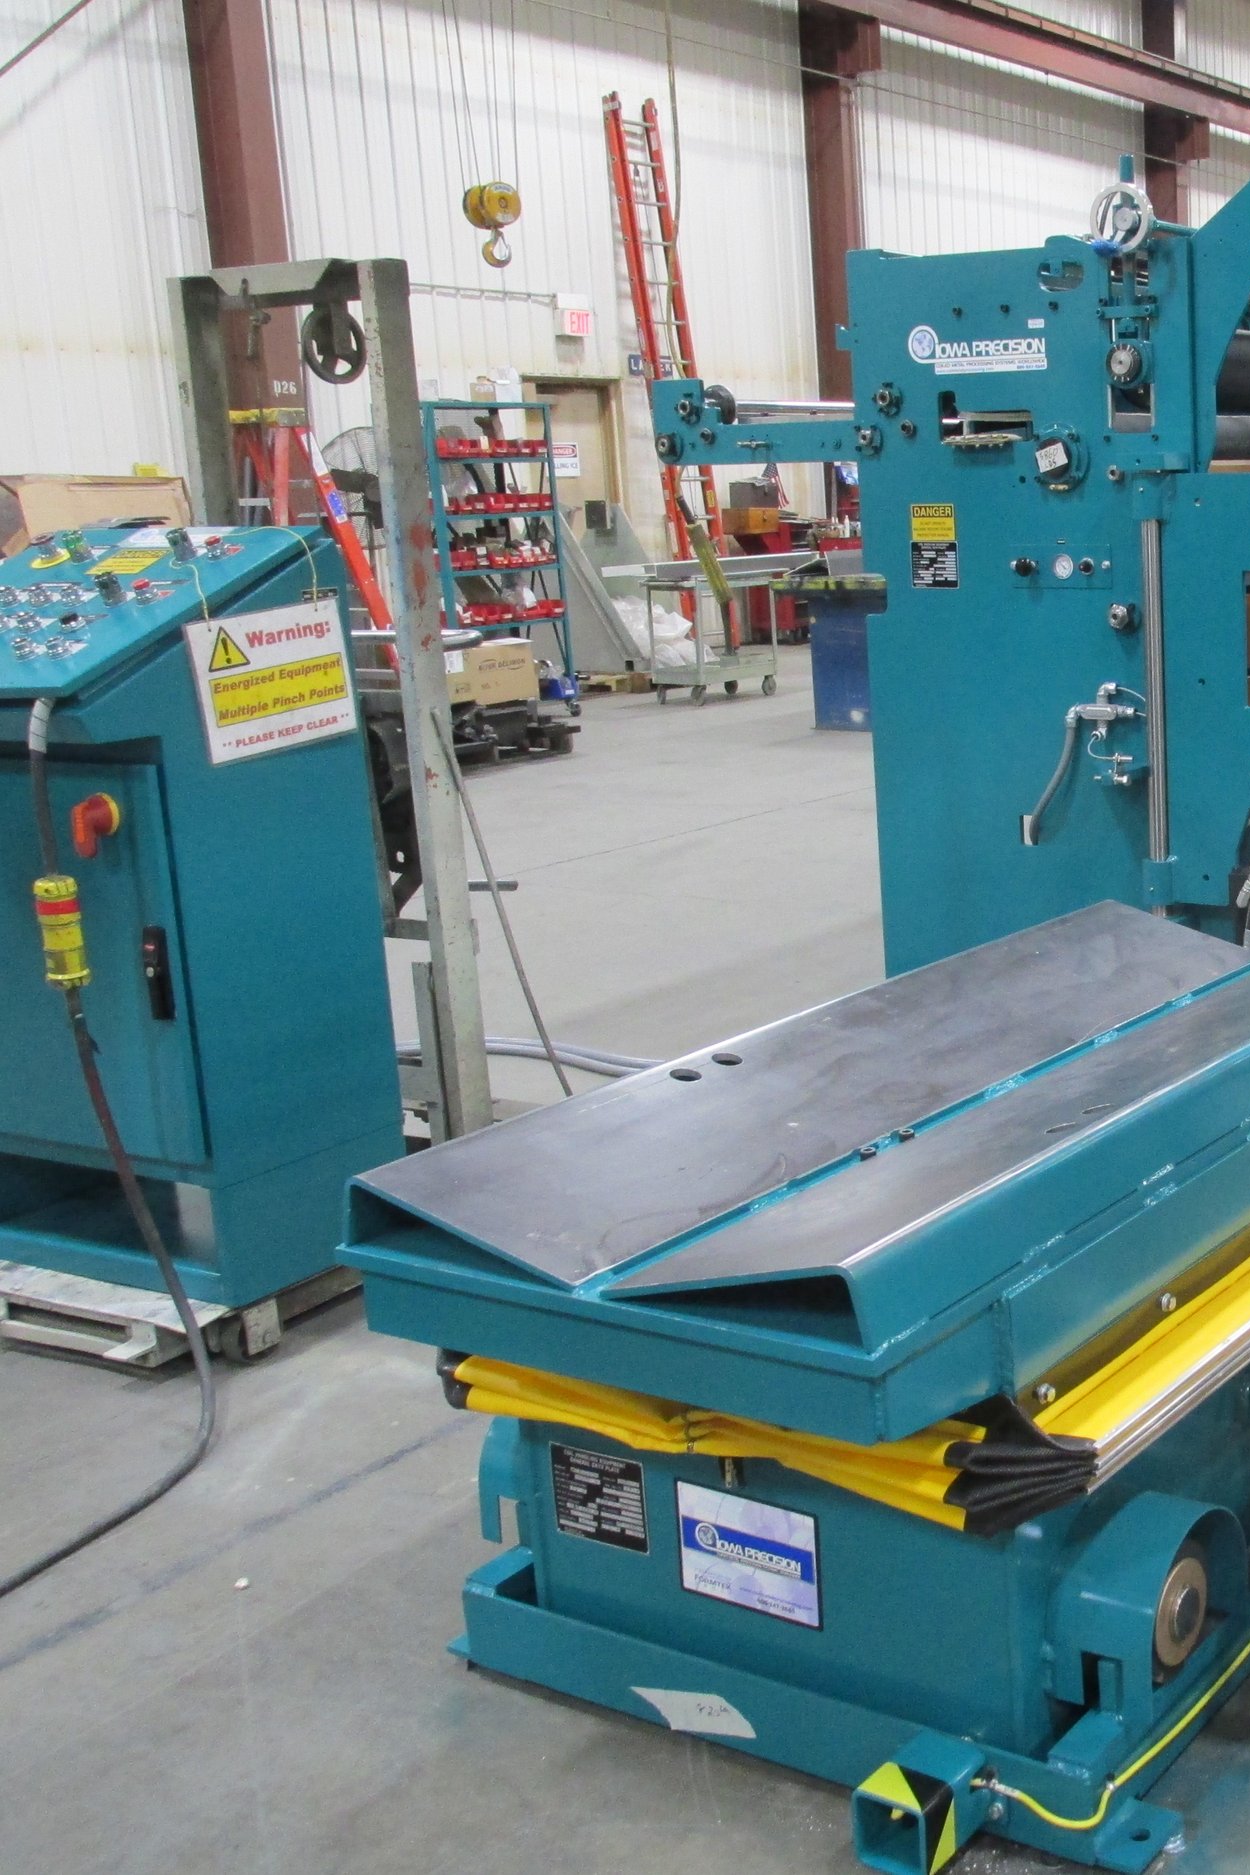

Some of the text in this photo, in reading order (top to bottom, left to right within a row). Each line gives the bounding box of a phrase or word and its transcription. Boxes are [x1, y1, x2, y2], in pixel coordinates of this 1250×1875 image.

[569, 311, 590, 334] EXIT
[935, 337, 1046, 359] IOWA PRECISION
[273, 380, 298, 395] D26
[913, 506, 952, 517] DANGER
[245, 620, 331, 649] Warning:
[213, 657, 342, 695] Energized Equipment
[218, 683, 345, 722] Multiple Pinch Points
[235, 715, 339, 748] PLEASE KEEP CLEAR
[717, 1539, 744, 1557] IOWA
[744, 1547, 802, 1574] PRECISION
